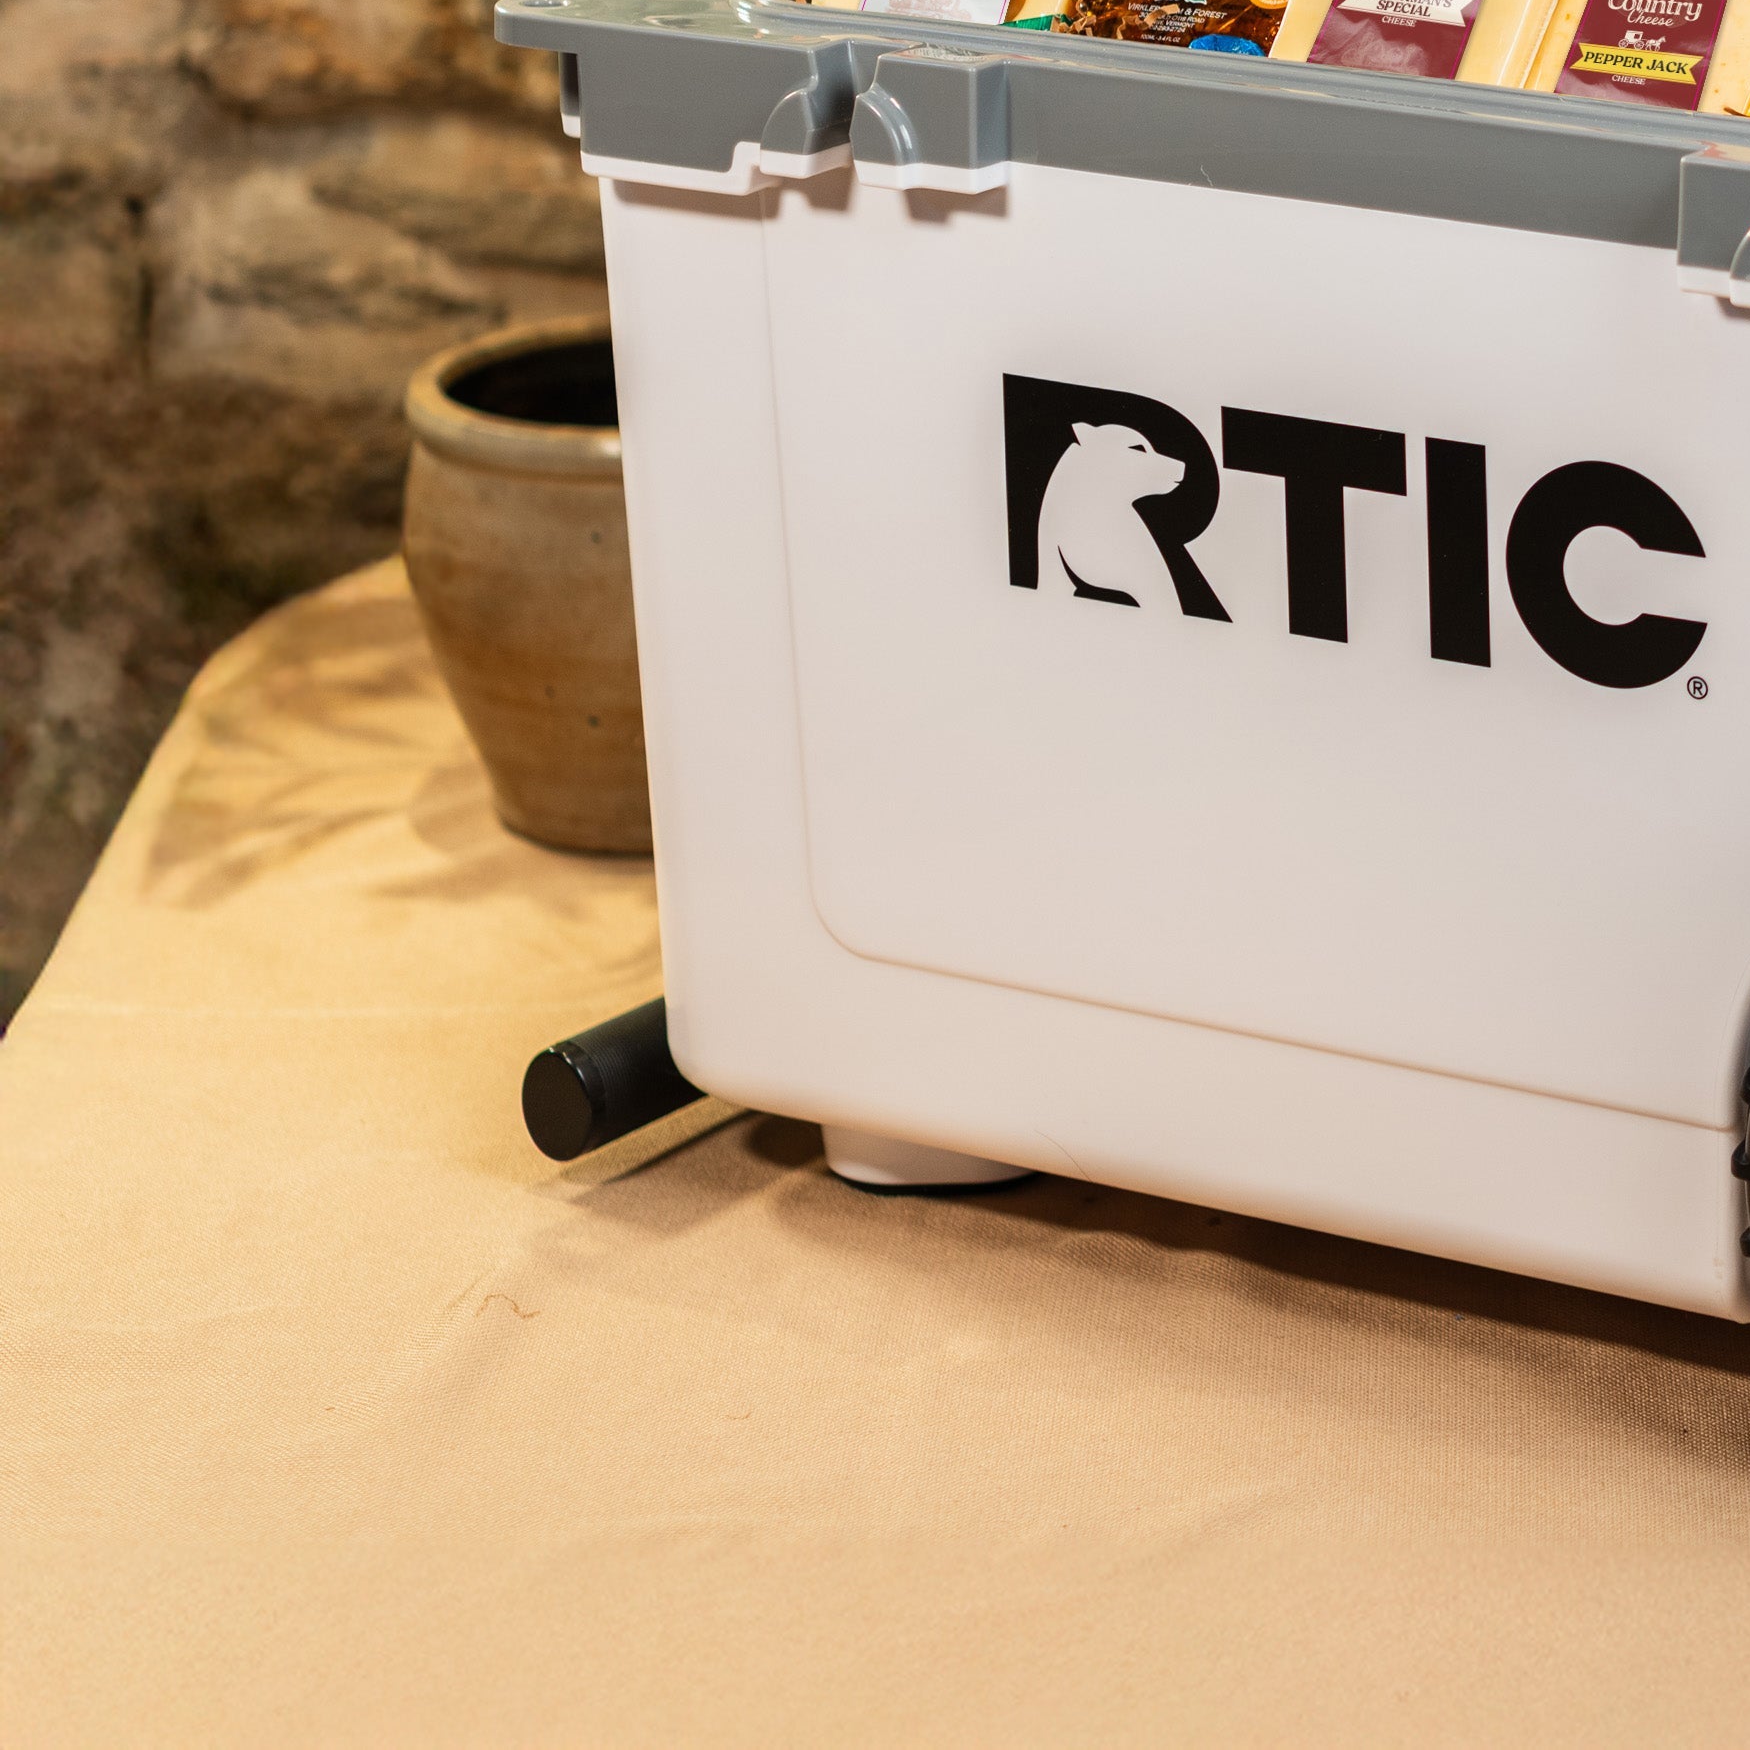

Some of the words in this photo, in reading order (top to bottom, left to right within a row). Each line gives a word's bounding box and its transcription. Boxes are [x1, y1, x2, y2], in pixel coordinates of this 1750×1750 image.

[1192, 8, 1228, 19] FOREST
[1376, 0, 1431, 18] SPECIAL
[1165, 20, 1196, 28] VERMONT
[1381, 15, 1417, 28] CHEESE
[1627, 8, 1675, 27] Cheese
[1583, 50, 1644, 70] PEPPER
[1646, 59, 1689, 75] JACK
[1611, 74, 1647, 86] CHEESE
[1002, 372, 1708, 689] RTIC
